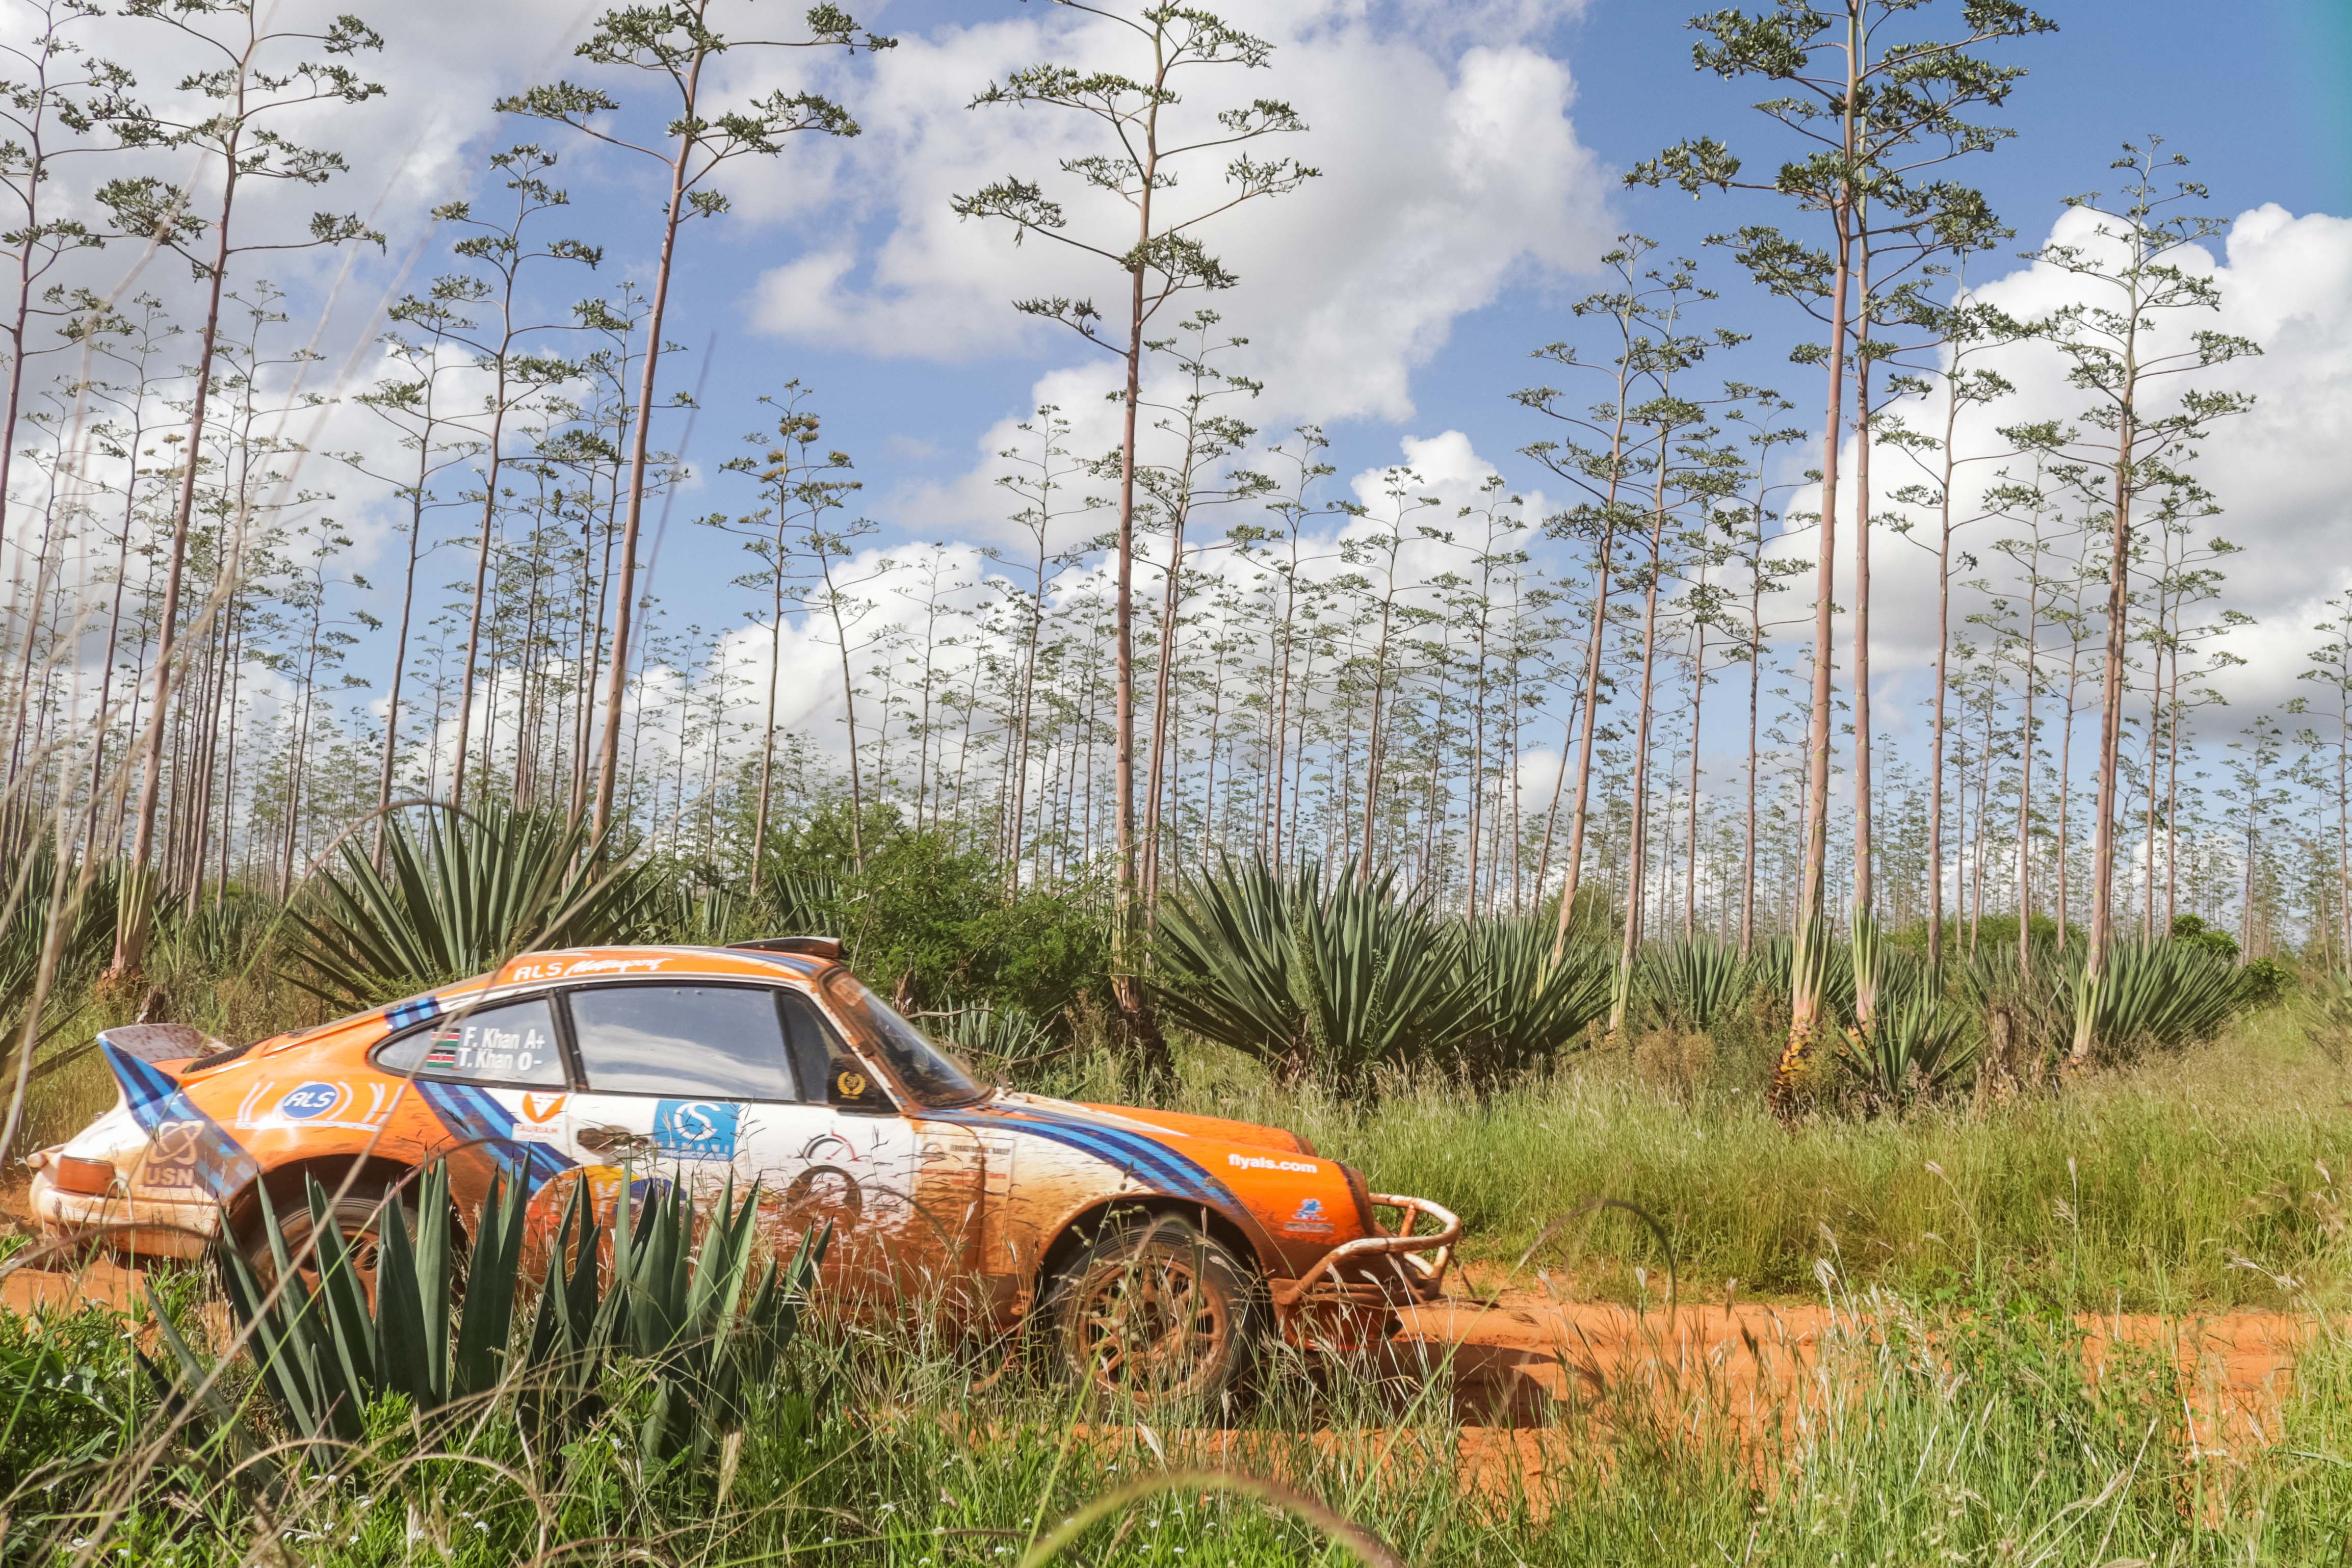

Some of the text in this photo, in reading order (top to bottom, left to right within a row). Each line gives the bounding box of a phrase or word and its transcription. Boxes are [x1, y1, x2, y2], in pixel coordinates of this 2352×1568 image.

[513, 962, 563, 981] ALS
[463, 1026, 545, 1049] F. Khan A+
[458, 1047, 473, 1068] T.
[475, 1048, 514, 1069] Khan
[283, 1091, 336, 1108] ALS
[1228, 1154, 1318, 1173] flyals.com
[144, 1167, 194, 1186] USN
